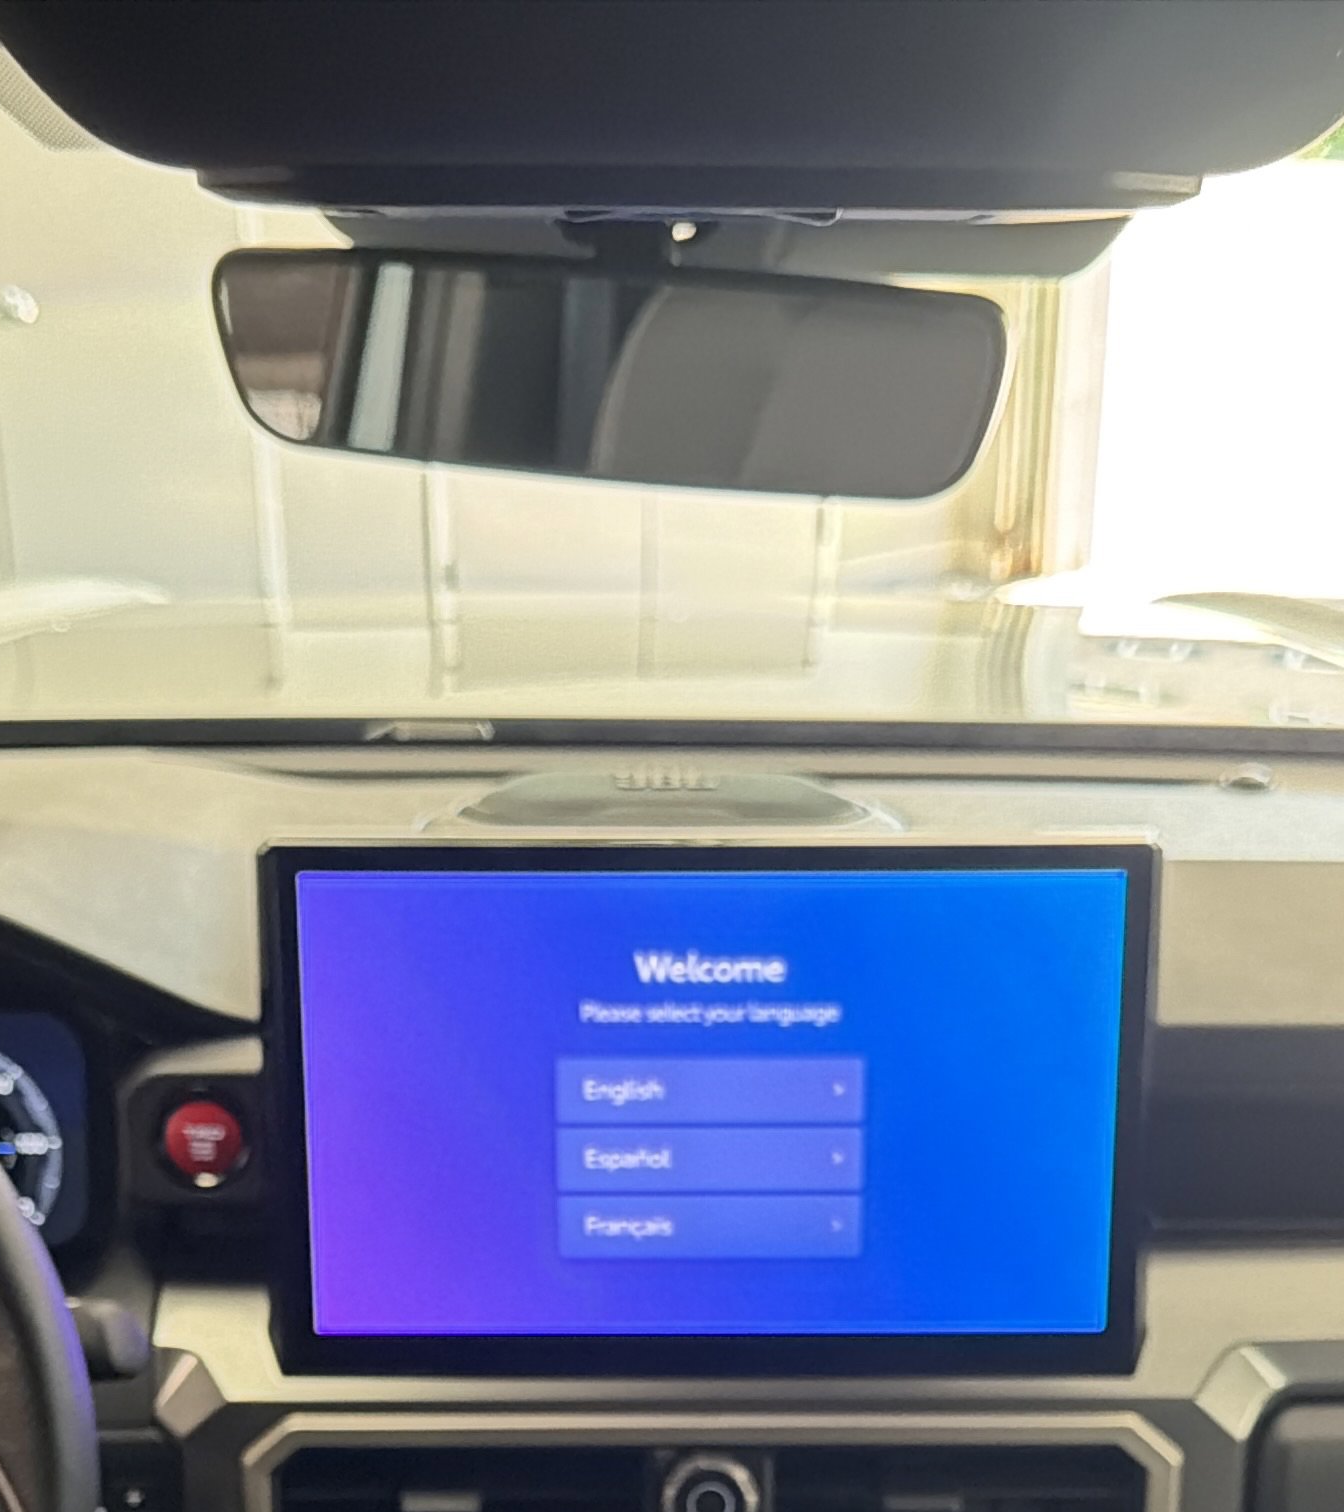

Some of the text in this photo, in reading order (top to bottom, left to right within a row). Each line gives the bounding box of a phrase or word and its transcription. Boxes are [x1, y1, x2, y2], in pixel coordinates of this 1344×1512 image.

[633, 948, 787, 983] Welcome
[579, 1000, 843, 1027] Please select your language
[582, 1077, 665, 1107] English
[584, 1147, 673, 1173] Español
[584, 1215, 675, 1241] Français
